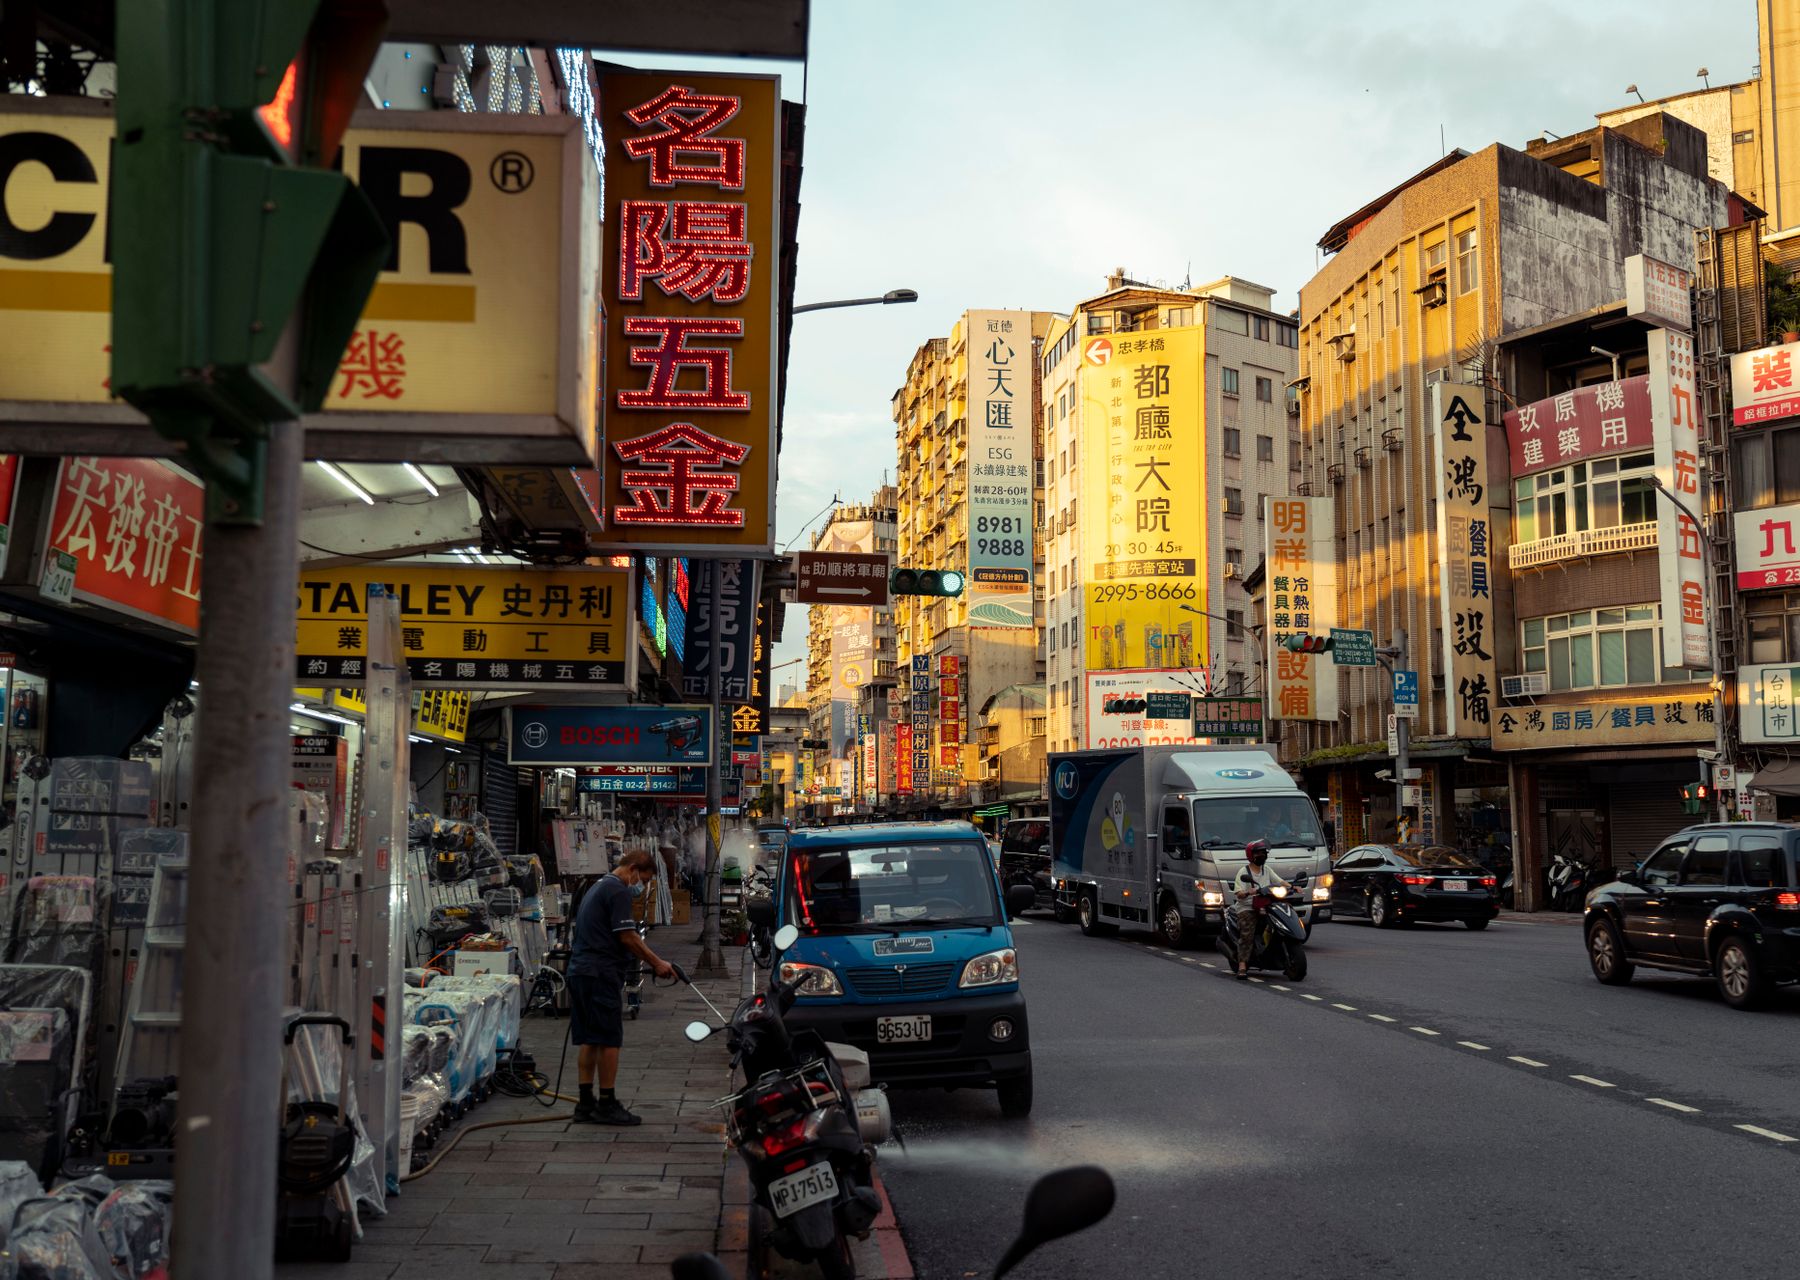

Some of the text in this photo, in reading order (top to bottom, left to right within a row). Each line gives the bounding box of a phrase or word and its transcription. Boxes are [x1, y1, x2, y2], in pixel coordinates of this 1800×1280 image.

[612, 84, 754, 528] 名陽五金
[986, 319, 1013, 333] 冠德
[1118, 337, 1165, 355] 忠孝橋
[985, 336, 1015, 429] 心天匯
[1752, 350, 1792, 393] 裝
[1517, 381, 1652, 433] 玖原機
[988, 447, 1013, 460] ESG
[1111, 376, 1122, 525] 新北第二行政中心
[1133, 363, 1172, 533] 都廳大院
[1522, 416, 1655, 467] 建築用
[974, 463, 1028, 477] 永續綠建築
[1671, 383, 1704, 625] 九宏五金
[976, 516, 1022, 534] 8981
[1273, 501, 1308, 572] 明祥
[1759, 518, 1797, 558] 九
[977, 538, 1025, 556] 9888
[1469, 517, 1489, 600] 餐具
[51, 573, 72, 597] 240
[812, 561, 886, 578] 助順將軍廟
[1103, 560, 1185, 578] 捷運先嗇宮站
[293, 581, 486, 617] TALEY
[499, 583, 612, 620] 史丹利
[1094, 582, 1197, 603] 2995-8666
[1273, 576, 1291, 647] 餐具器材
[1092, 625, 1123, 640] TOP
[1149, 632, 1191, 650] CITY
[1276, 650, 1309, 716] 設備
[1395, 673, 1405, 690] P
[1454, 609, 1493, 726] 設備
[1770, 674, 1788, 732] 台北市
[560, 726, 640, 746] BOSCH
[866, 743, 875, 778] YAMAHA
